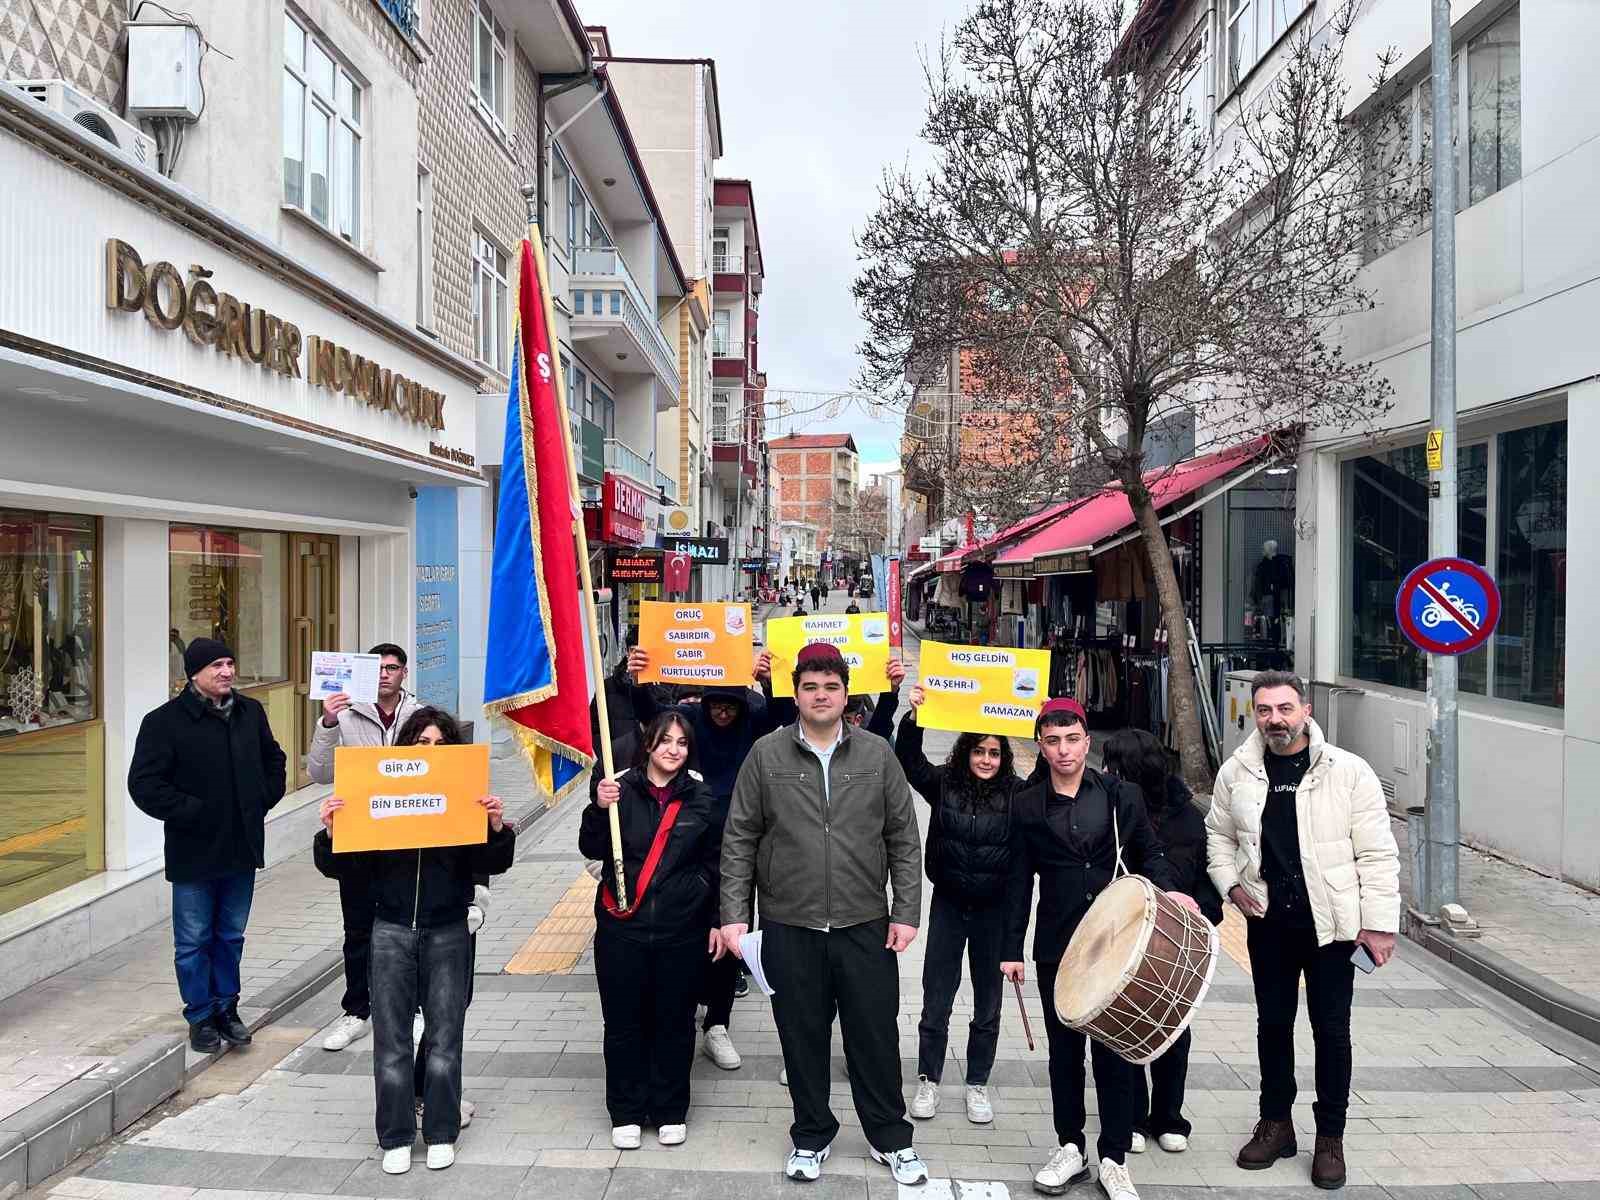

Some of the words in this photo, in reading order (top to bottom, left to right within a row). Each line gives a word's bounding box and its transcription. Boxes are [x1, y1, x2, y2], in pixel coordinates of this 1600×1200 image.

[105, 238, 302, 379] DOĞRUER
[675, 609, 702, 621] ORUÇ
[804, 620, 844, 630] RAHMET
[668, 631, 711, 641] SABIRDIR
[676, 650, 703, 659] SABIR
[951, 652, 971, 663] HOŞ
[973, 652, 1009, 663] GELDİN
[661, 667, 724, 678] KURTULUŞTUR
[928, 678, 941, 687] YA
[983, 705, 1034, 718] RAMAZAN
[385, 761, 403, 773] BİR
[406, 762, 421, 773] AY
[372, 798, 391, 809] BİN
[394, 798, 442, 809] BEREKET
